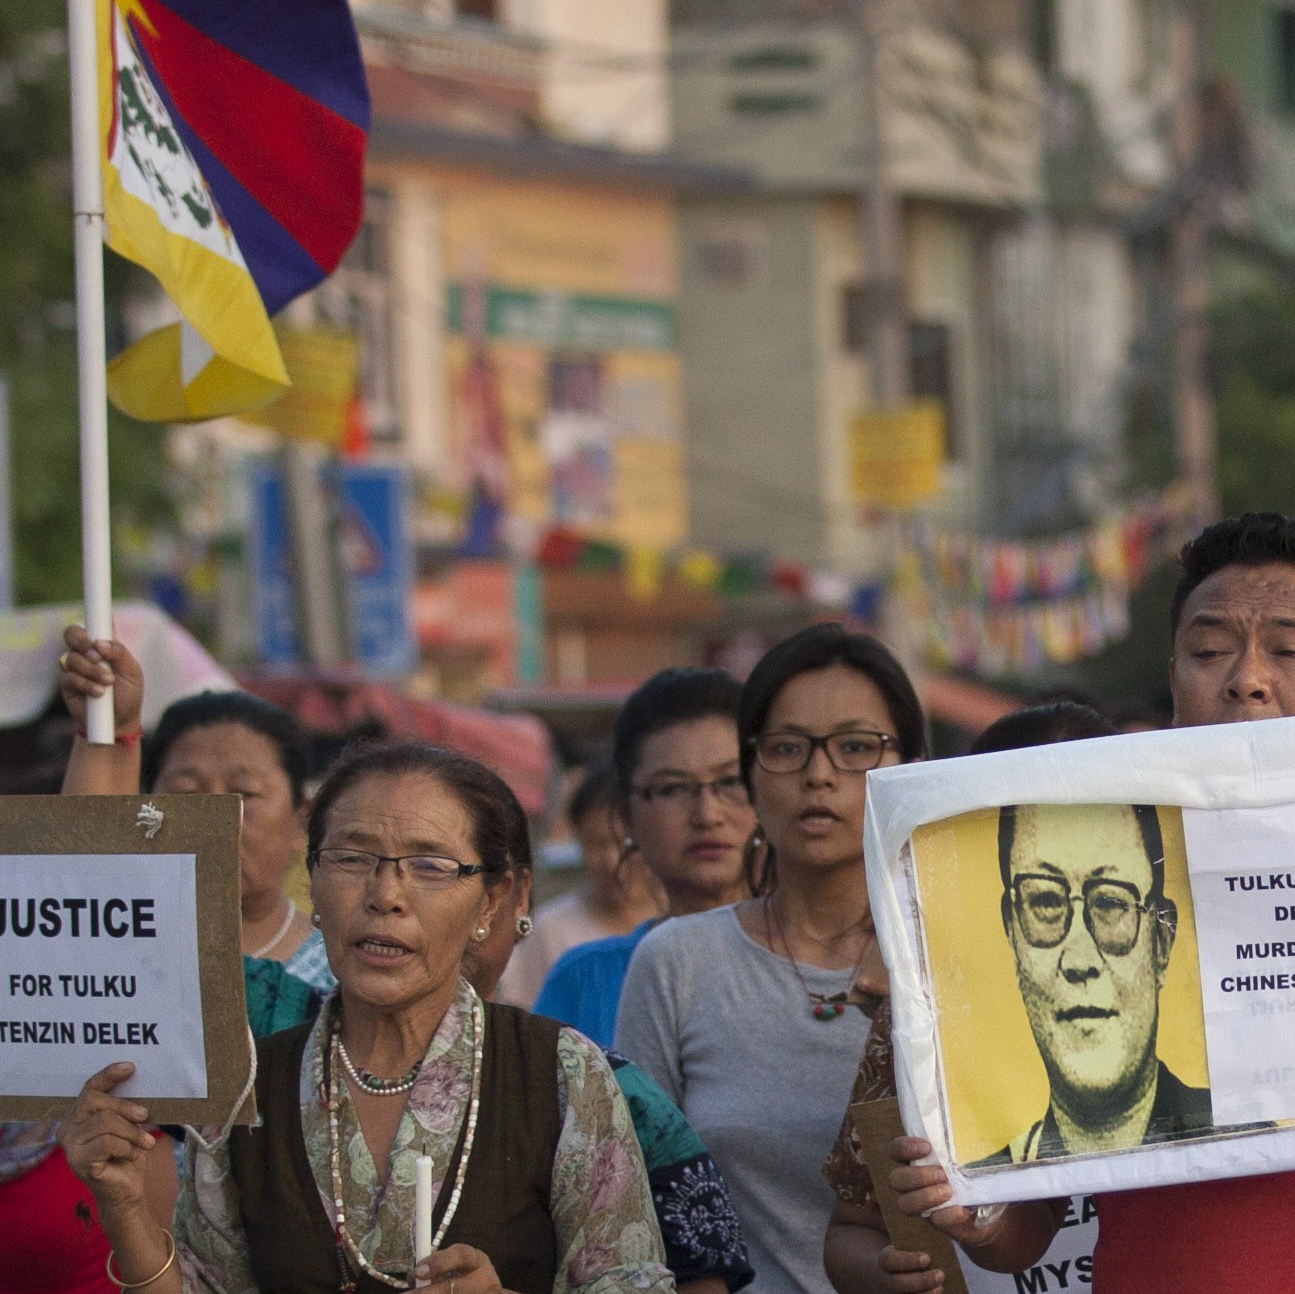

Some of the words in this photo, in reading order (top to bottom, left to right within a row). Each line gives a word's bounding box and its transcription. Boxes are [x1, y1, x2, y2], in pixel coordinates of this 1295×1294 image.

[9, 973, 54, 997] FOR
[58, 974, 137, 998] TULKU
[82, 1021, 160, 1046] DELEK
